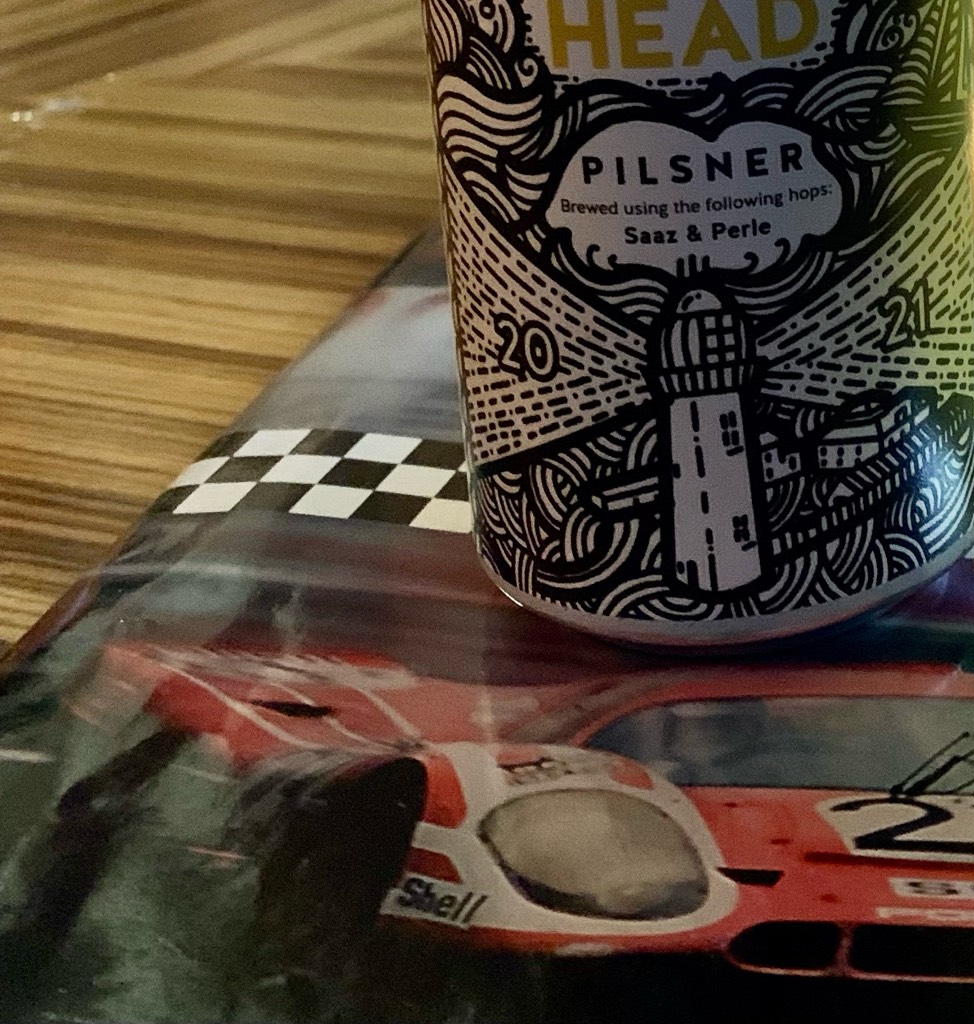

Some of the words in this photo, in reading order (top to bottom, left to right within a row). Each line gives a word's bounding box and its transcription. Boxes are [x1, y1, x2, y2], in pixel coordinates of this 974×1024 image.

[582, 142, 804, 186] PILSNER
[561, 198, 619, 216] Brewed
[624, 200, 669, 219] using
[674, 199, 700, 215] the
[706, 189, 783, 213] following
[788, 183, 834, 203] hops:
[625, 226, 679, 245] Saaz
[686, 224, 703, 243] &
[712, 219, 772, 241] Perle
[882, 281, 928, 349] 21
[496, 317, 557, 379] 20
